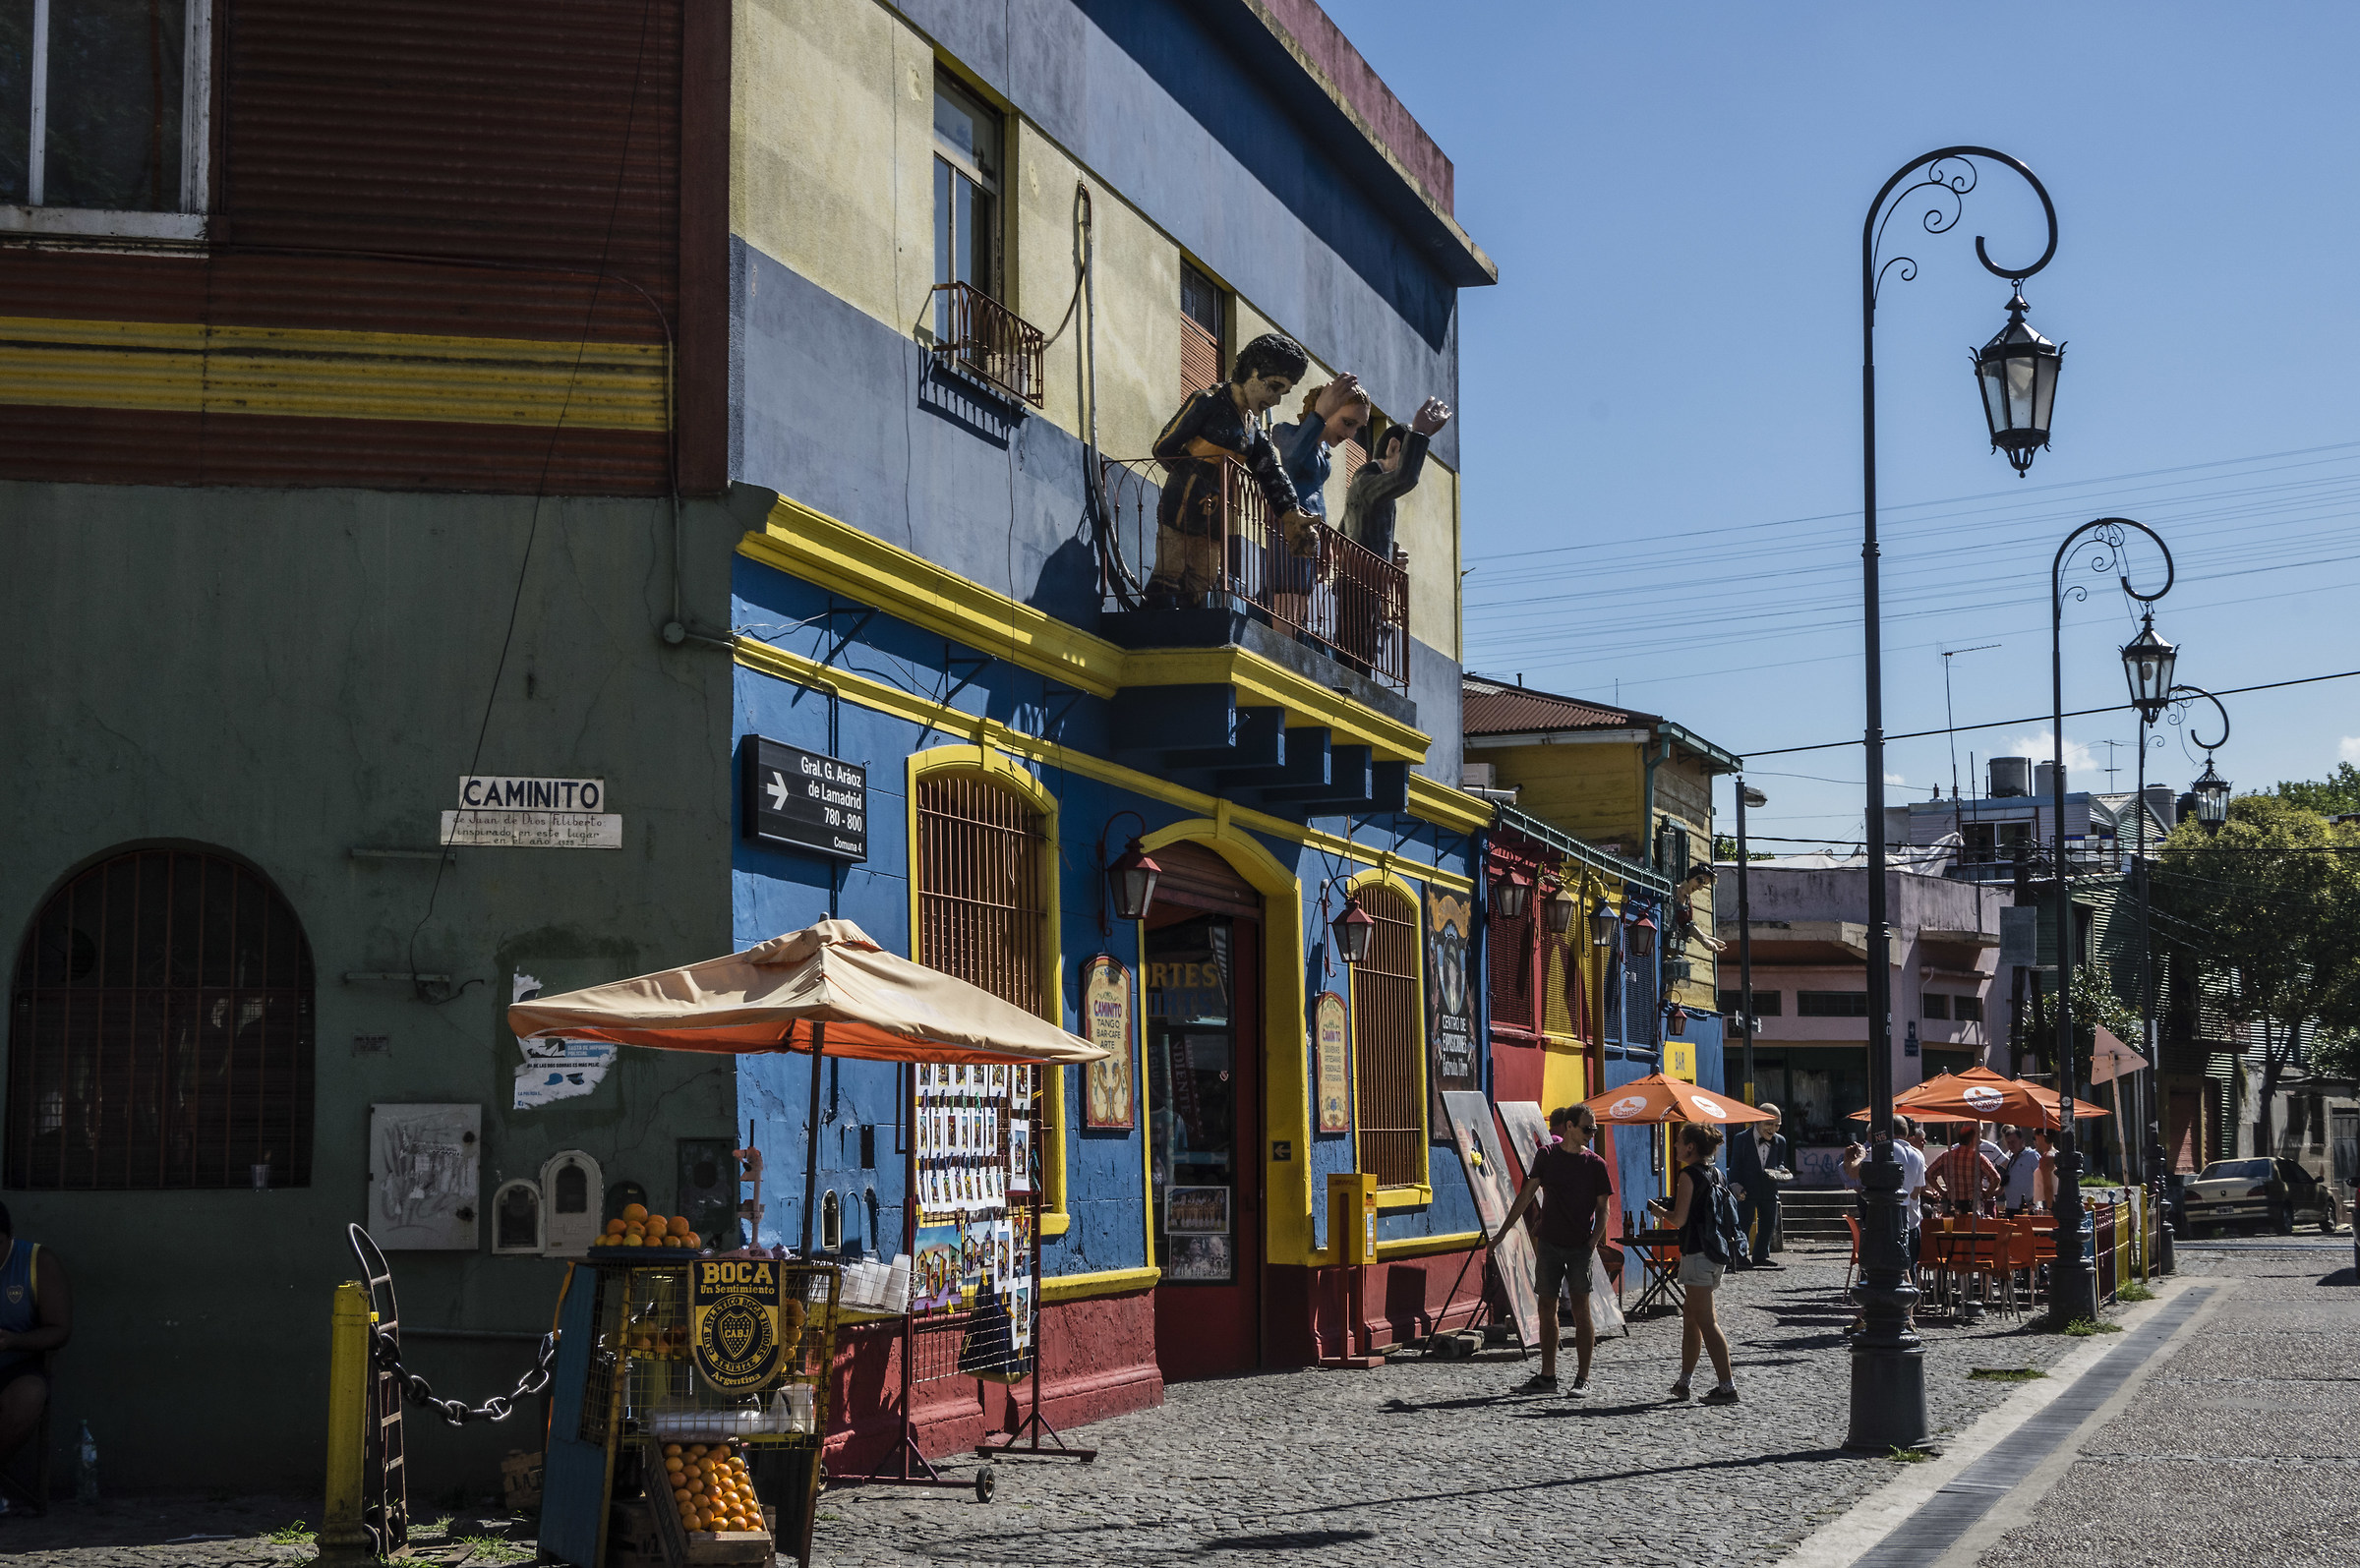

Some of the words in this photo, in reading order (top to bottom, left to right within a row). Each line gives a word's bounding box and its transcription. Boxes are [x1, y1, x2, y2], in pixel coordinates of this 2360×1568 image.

[800, 756, 823, 778] Gral.
[824, 762, 835, 781] G.
[837, 765, 861, 788] Aráoz
[464, 780, 600, 809] CAMINITO
[808, 780, 820, 798] de
[821, 783, 862, 810] Lamadrid
[469, 814, 499, 827] Juan
[504, 814, 518, 825] de
[521, 813, 546, 826] Dios
[824, 807, 840, 827] 780
[847, 813, 862, 833] 800
[529, 836, 550, 846] año
[537, 828, 560, 839] este
[567, 828, 601, 843] lugar
[833, 836, 857, 852] Comuna
[857, 842, 863, 853] 4
[1093, 999, 1123, 1018] CAMINITO
[1097, 1018, 1121, 1029] TANGO
[1443, 1015, 1459, 1031] CENTRO
[1460, 1017, 1467, 1032] DE
[1100, 1039, 1115, 1049] ARTE
[701, 1261, 775, 1285] BOCA
[700, 1284, 714, 1294] Un
[715, 1284, 775, 1296] Sentimiento
[704, 1297, 740, 1330] ATLETICO
[741, 1298, 763, 1317] BOCA
[724, 1328, 750, 1339] CABJ
[756, 1317, 773, 1359] JUNIORS
[702, 1329, 715, 1357] CLUB
[714, 1358, 756, 1372] XENEIZE
[711, 1370, 762, 1386] Argentina
